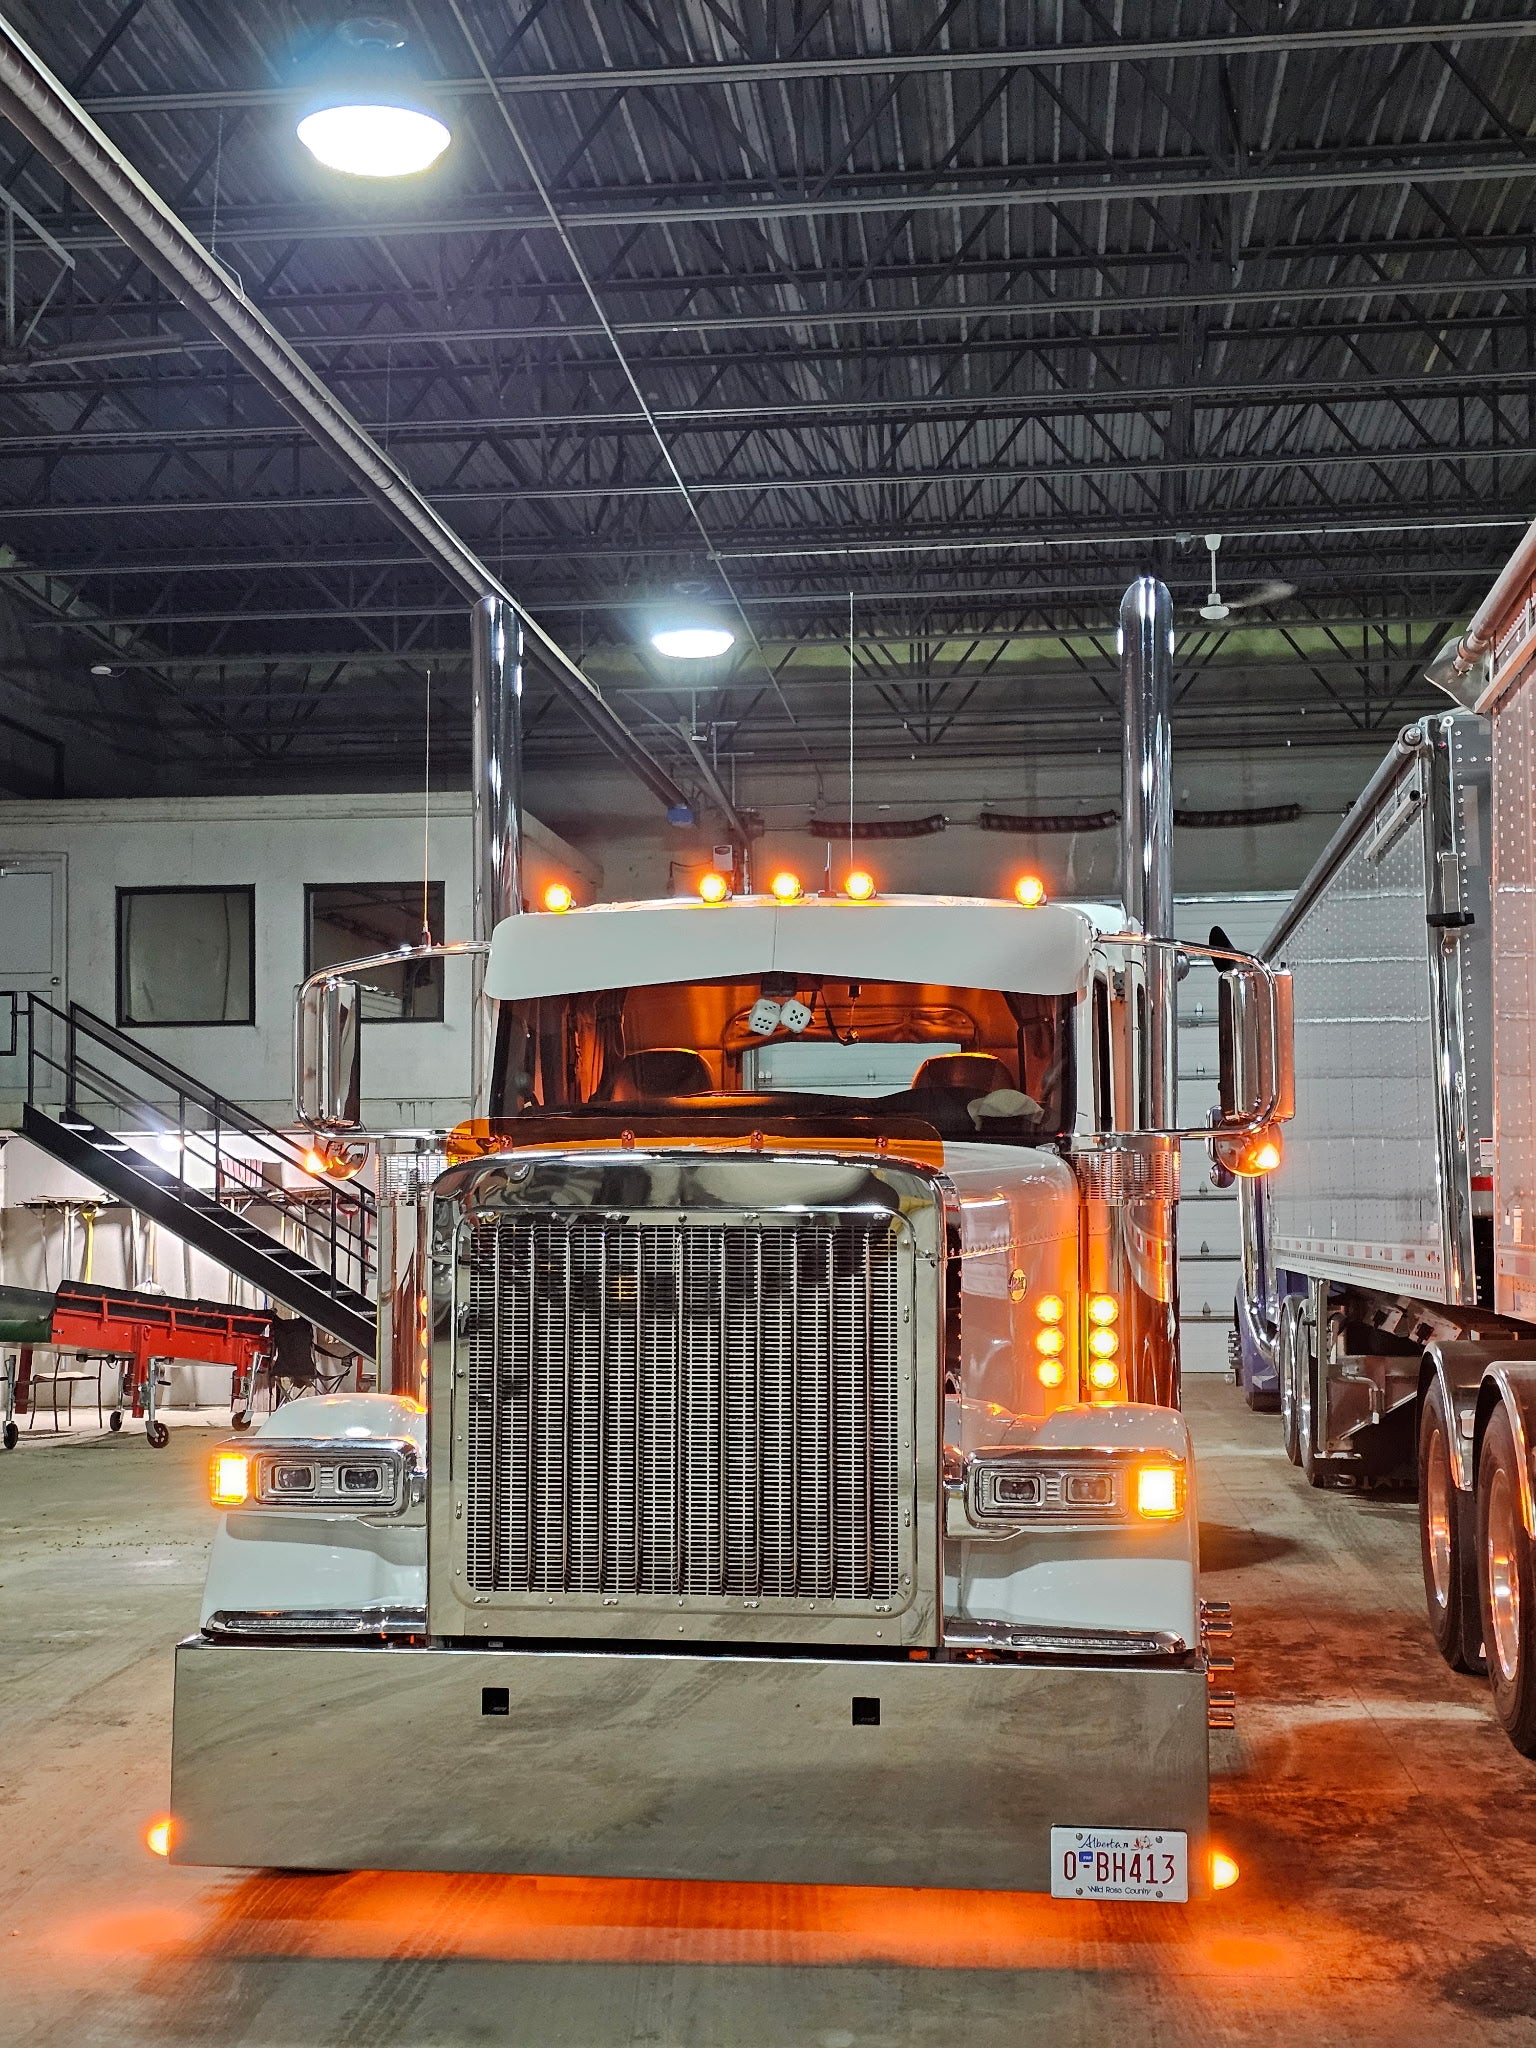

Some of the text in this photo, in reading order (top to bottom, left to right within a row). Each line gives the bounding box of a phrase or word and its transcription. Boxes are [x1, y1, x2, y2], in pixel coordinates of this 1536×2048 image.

[1087, 1885, 1151, 1895] Wild Rose Country
